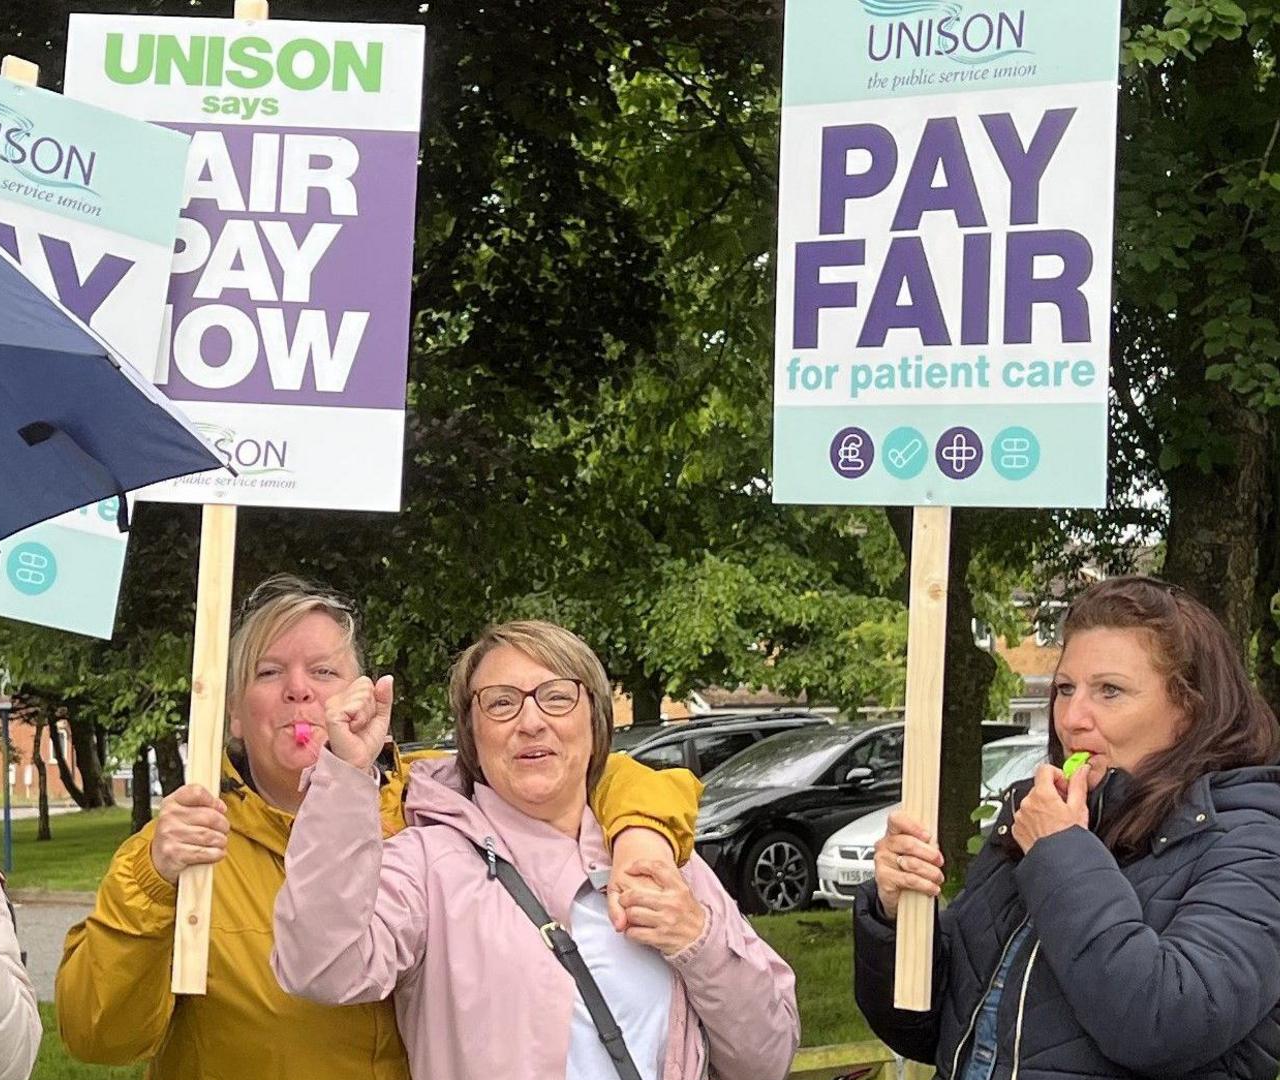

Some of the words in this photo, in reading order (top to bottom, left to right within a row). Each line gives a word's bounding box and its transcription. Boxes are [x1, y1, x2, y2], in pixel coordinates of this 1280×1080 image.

[868, 10, 1025, 61] UNISON
[104, 33, 383, 93] UNISON
[867, 72, 888, 89] the
[892, 68, 934, 91] public
[938, 65, 989, 82] service
[993, 64, 1037, 78] union
[201, 95, 279, 120] says
[179, 130, 358, 216] AIR
[819, 107, 1077, 235] PAY
[1, 178, 54, 202] service
[57, 195, 102, 217] union
[170, 217, 343, 302] PAY
[792, 229, 1094, 349] FAIR
[787, 358, 838, 390] for
[851, 355, 990, 398] patient
[1002, 358, 1095, 388] care
[260, 478, 297, 490] union
